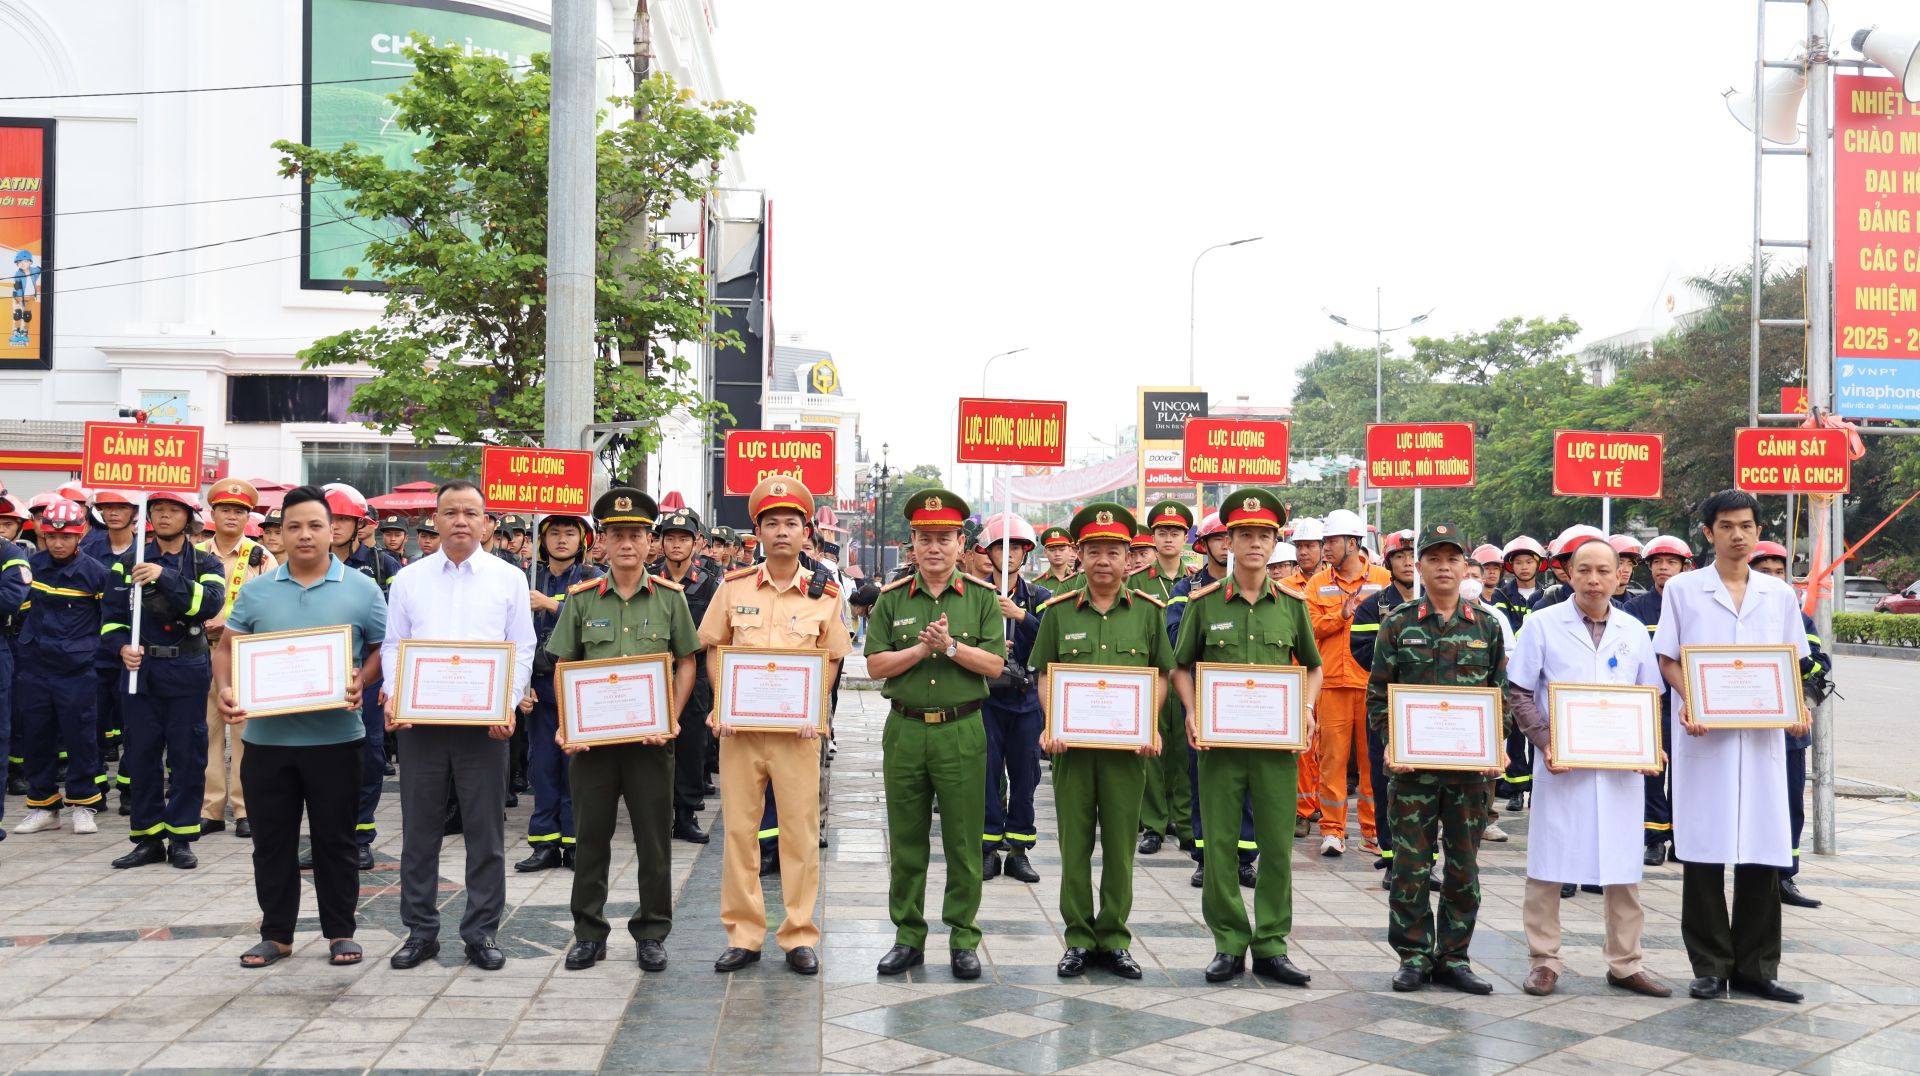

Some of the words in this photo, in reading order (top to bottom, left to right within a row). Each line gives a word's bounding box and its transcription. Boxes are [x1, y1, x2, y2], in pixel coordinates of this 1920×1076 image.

[1851, 86, 1904, 120] NHIỆT
[1844, 125, 1894, 154] CHÀO
[0, 177, 40, 191] ATIN
[1865, 169, 1897, 198] ĐẠI
[1859, 201, 1911, 233] ĐẢNG
[1860, 243, 1898, 272] CÁC
[1855, 283, 1917, 317] NHIỆM
[1842, 326, 1889, 351] 2025
[1907, 328, 1920, 352] 2
[1857, 367, 1898, 376] VNPT
[1152, 401, 1201, 411] VINCOM
[103, 431, 149, 456] CẢNH
[153, 436, 185, 458] SÁT
[965, 413, 983, 451] LỰC
[984, 414, 1015, 452] LƯỢNG
[1016, 412, 1042, 450] QUÂN
[1043, 413, 1060, 454] ĐỘI
[1208, 428, 1228, 450] LỰC
[1230, 429, 1265, 451] LƯỢNG
[1396, 432, 1413, 453] LỰC
[1415, 431, 1444, 452] LƯỢNG
[738, 440, 767, 461] LỰC
[771, 441, 822, 462] LƯỢNG
[1567, 441, 1596, 462] LỰC
[1599, 442, 1649, 464] LƯỢNG
[1757, 435, 1797, 456] CẢNH
[1800, 436, 1827, 456] SÁT
[93, 462, 133, 482] GIAO
[138, 461, 191, 484] THÔNG
[510, 455, 530, 477] LỰC
[531, 456, 565, 478] LƯỢNG
[1189, 453, 1219, 474] CÔNG
[1221, 458, 1237, 475] AN
[1238, 455, 1281, 476] PHƯỜNG
[1372, 457, 1393, 480] ĐIỆN
[1394, 459, 1414, 480] LỰC,
[1415, 456, 1433, 476] MÔI
[1434, 455, 1469, 476] TRƯỜNG
[1741, 467, 1779, 484] PCCC
[1782, 463, 1801, 484] VÀ
[1804, 467, 1844, 484] CNCH
[1592, 470, 1602, 487] Y
[1605, 466, 1624, 488] TẾ
[488, 479, 517, 502] CẢNH
[519, 482, 538, 503] SÁT
[540, 485, 555, 503] CƠ
[556, 484, 584, 508] ĐỘNG
